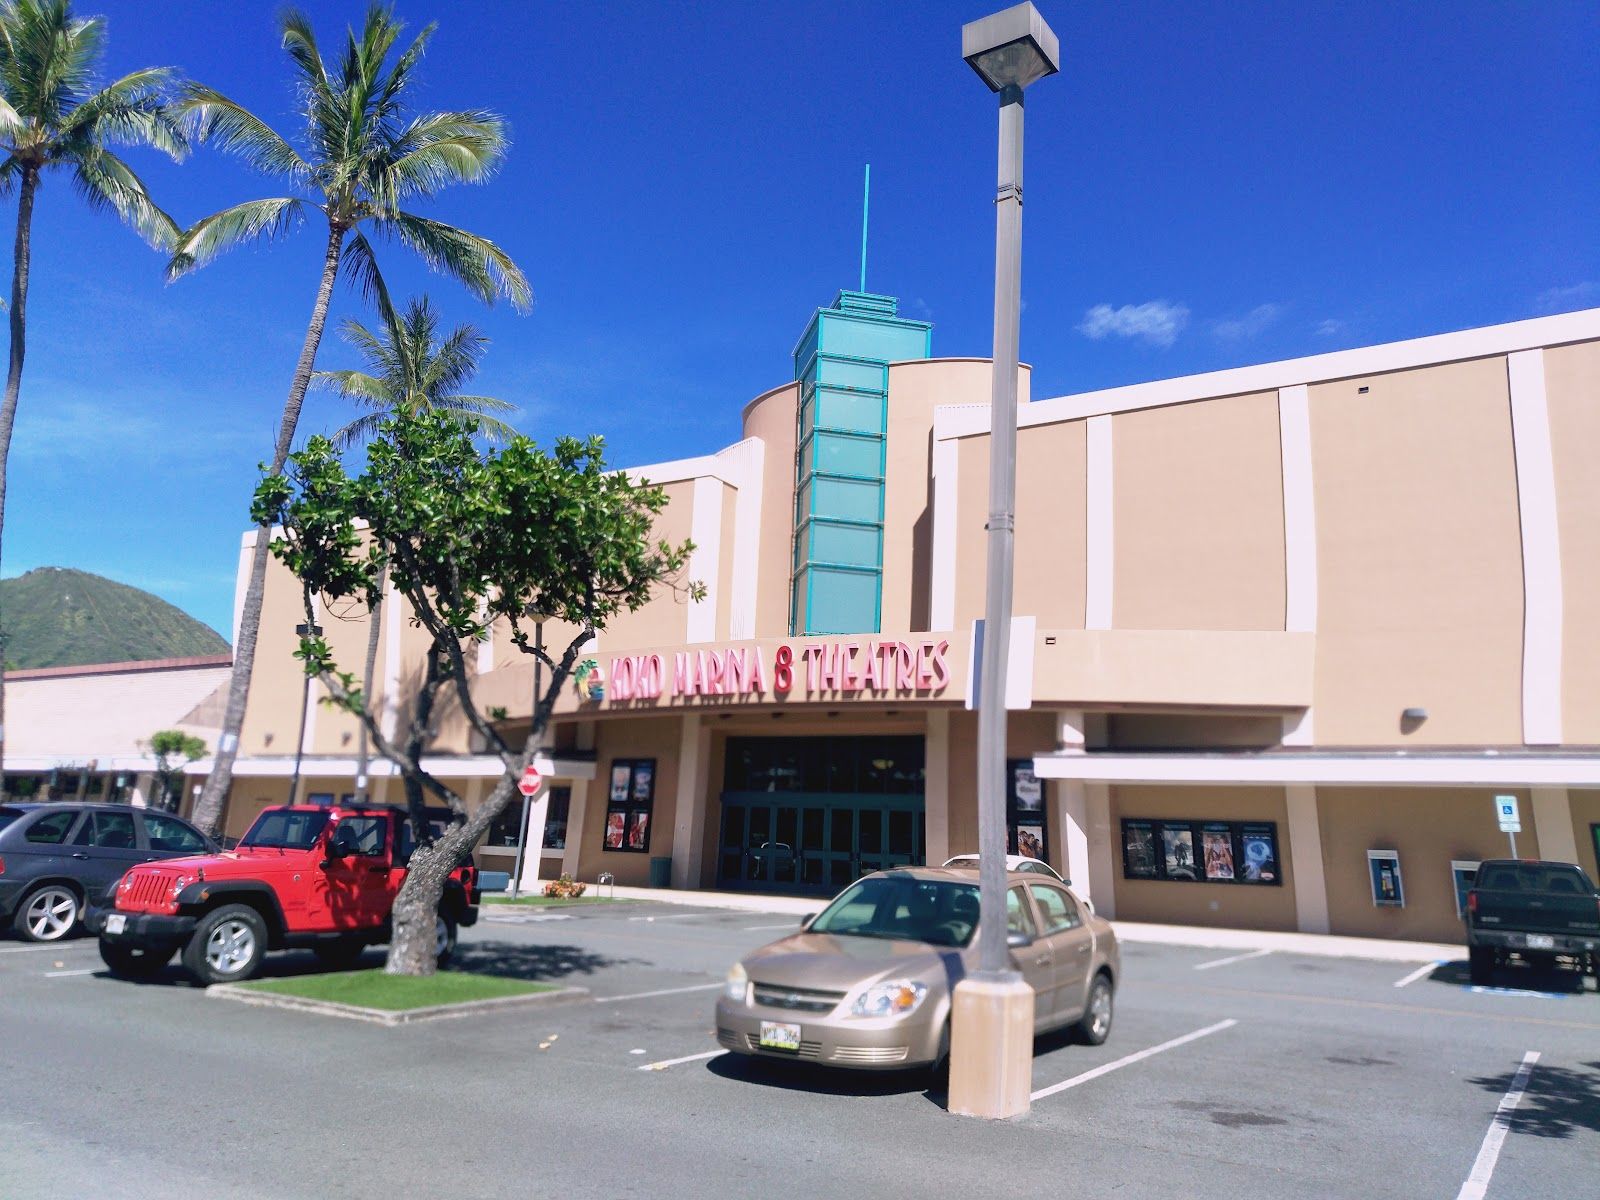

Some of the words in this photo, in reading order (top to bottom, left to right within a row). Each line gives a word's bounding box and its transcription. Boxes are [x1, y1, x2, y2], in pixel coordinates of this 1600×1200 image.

[610, 655, 665, 700] KOKO
[672, 646, 768, 696] MARINA
[774, 645, 794, 692] 8
[803, 640, 950, 691] THEATRES
